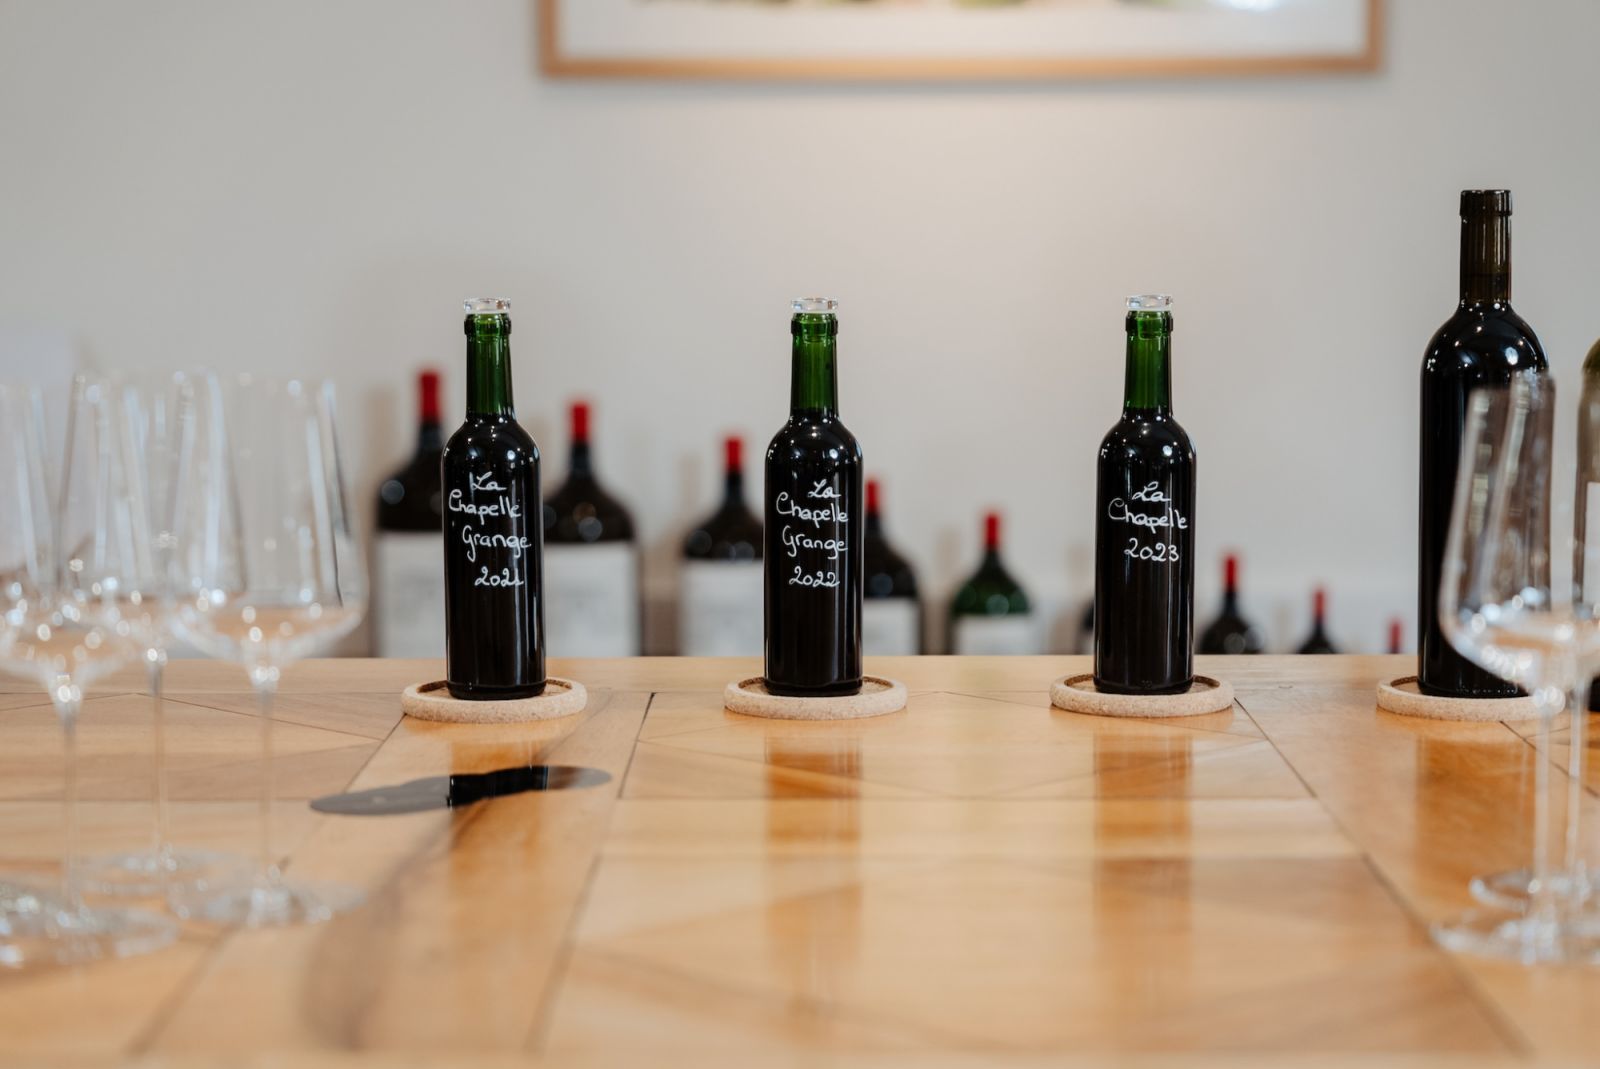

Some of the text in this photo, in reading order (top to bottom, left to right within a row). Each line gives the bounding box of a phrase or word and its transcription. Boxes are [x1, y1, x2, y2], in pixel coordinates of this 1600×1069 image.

[472, 471, 507, 490] La
[808, 479, 841, 498] La
[1132, 481, 1171, 502] La
[449, 489, 521, 525] Chapelle
[776, 491, 848, 528] Chapelle
[1108, 497, 1188, 534] Chapelle
[462, 525, 532, 563] Grange
[782, 525, 848, 559] Grange
[1124, 537, 1179, 562] 2023
[474, 566, 524, 587] 2021
[789, 566, 840, 587] 2022
